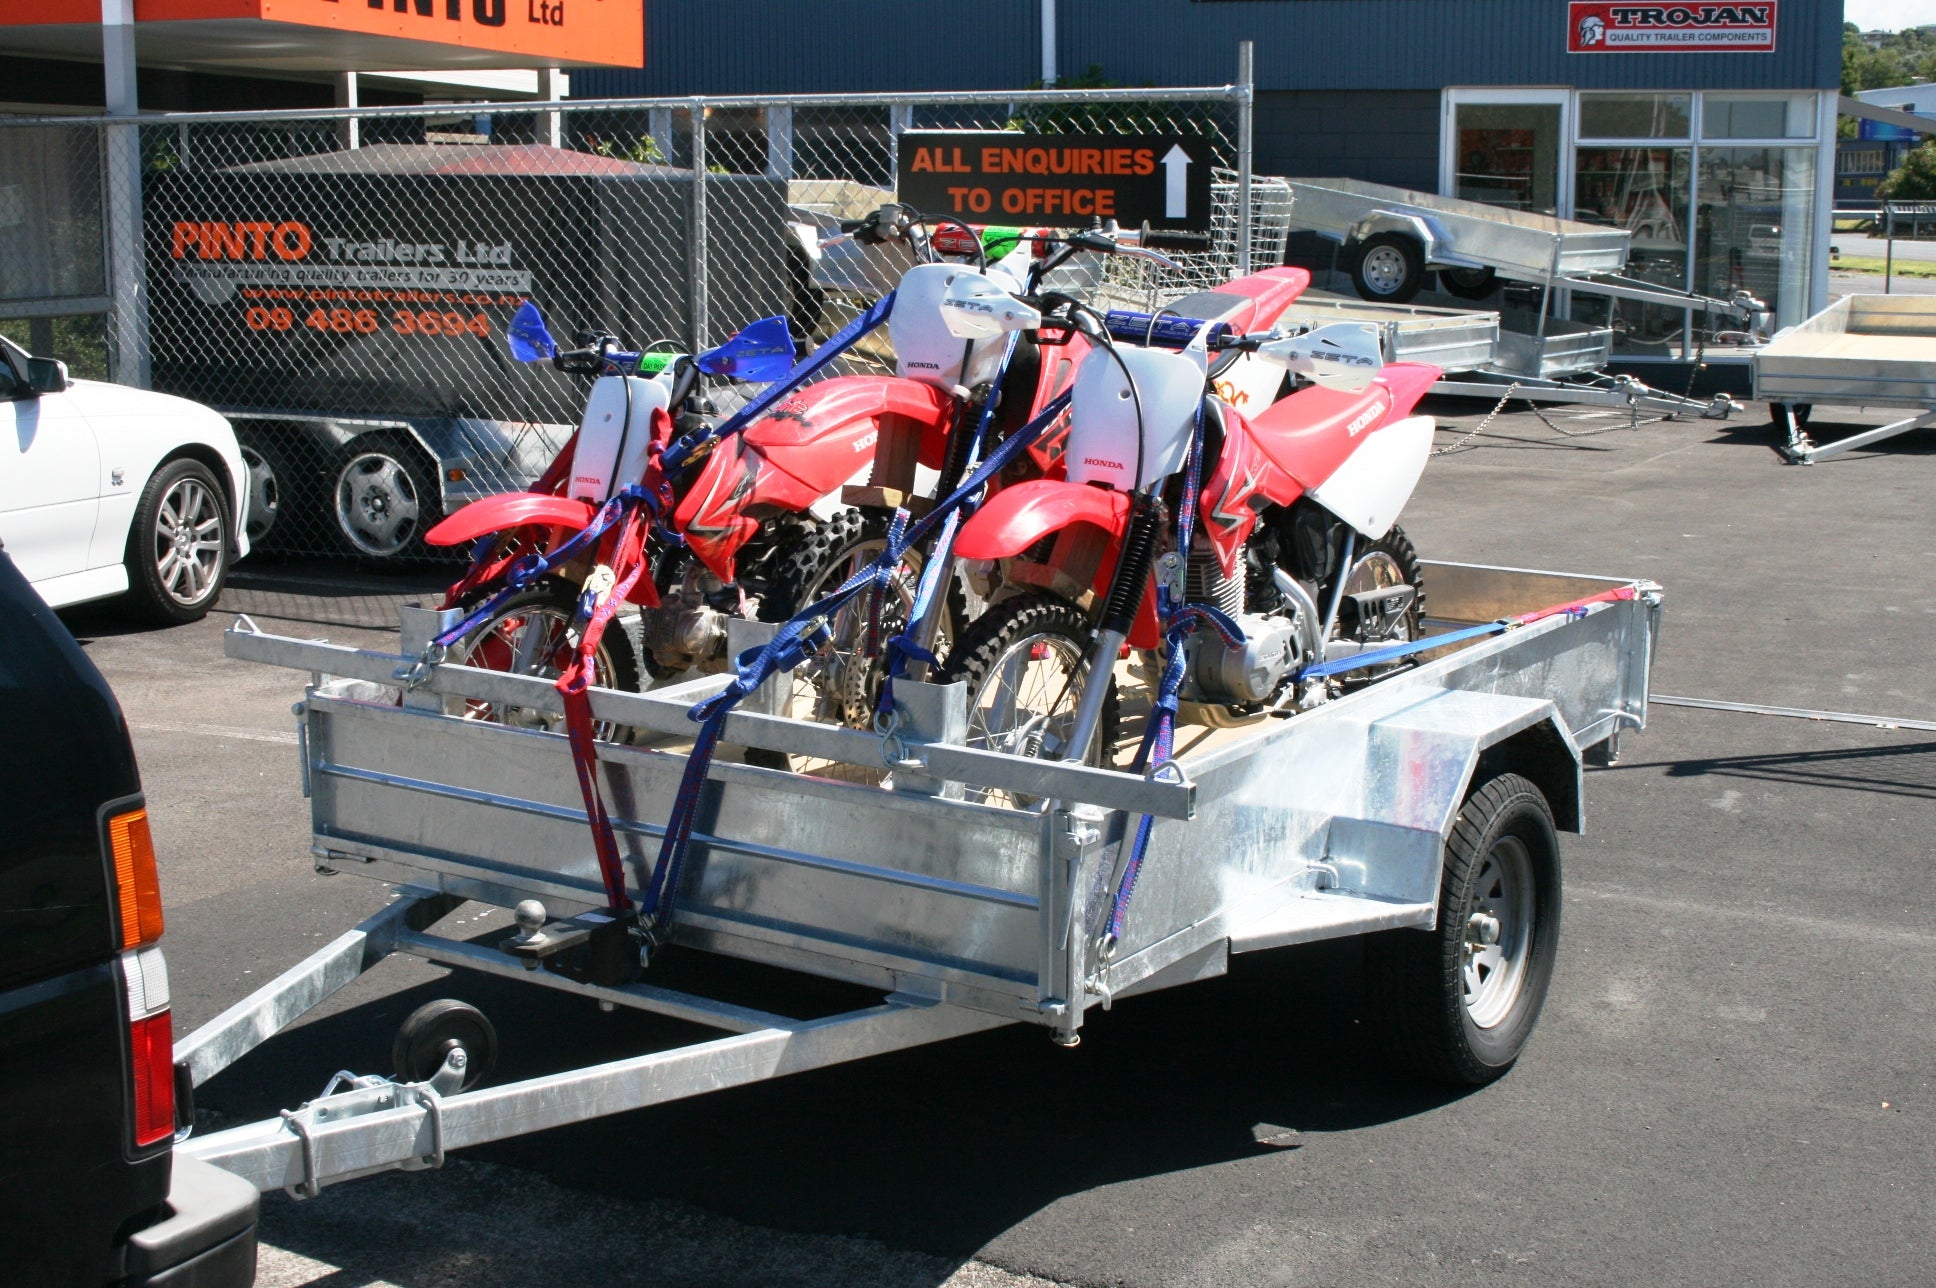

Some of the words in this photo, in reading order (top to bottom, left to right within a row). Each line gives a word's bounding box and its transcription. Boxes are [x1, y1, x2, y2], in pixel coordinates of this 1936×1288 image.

[528, 0, 564, 26] Ltd
[1610, 7, 1769, 27] TROJAN
[1609, 32, 1651, 42] QUALITY
[1654, 32, 1695, 42] TRAILER
[1698, 32, 1768, 42] COMPONENTS
[911, 147, 971, 173] ALL
[981, 148, 1156, 176] ENQUIRIES
[948, 187, 991, 213] TO
[1002, 188, 1115, 216] OFFICE
[172, 221, 312, 260] PINTO
[325, 238, 445, 262] Trailers
[457, 239, 513, 265] Ltd
[297, 267, 349, 284] quality
[357, 268, 411, 282] trailers
[419, 269, 441, 283] for
[943, 298, 994, 313] ZETA
[246, 306, 293, 331] 09
[305, 308, 378, 333] 486
[392, 310, 491, 338] 3694
[1107, 314, 1191, 332] ZETA
[736, 347, 784, 358] ZETA
[1309, 350, 1373, 366] ZETA
[907, 361, 939, 370] HONDA
[1347, 399, 1386, 438] HONDA
[852, 430, 878, 454] HON
[1083, 457, 1125, 470] HONDA
[574, 476, 601, 486] HONDA
